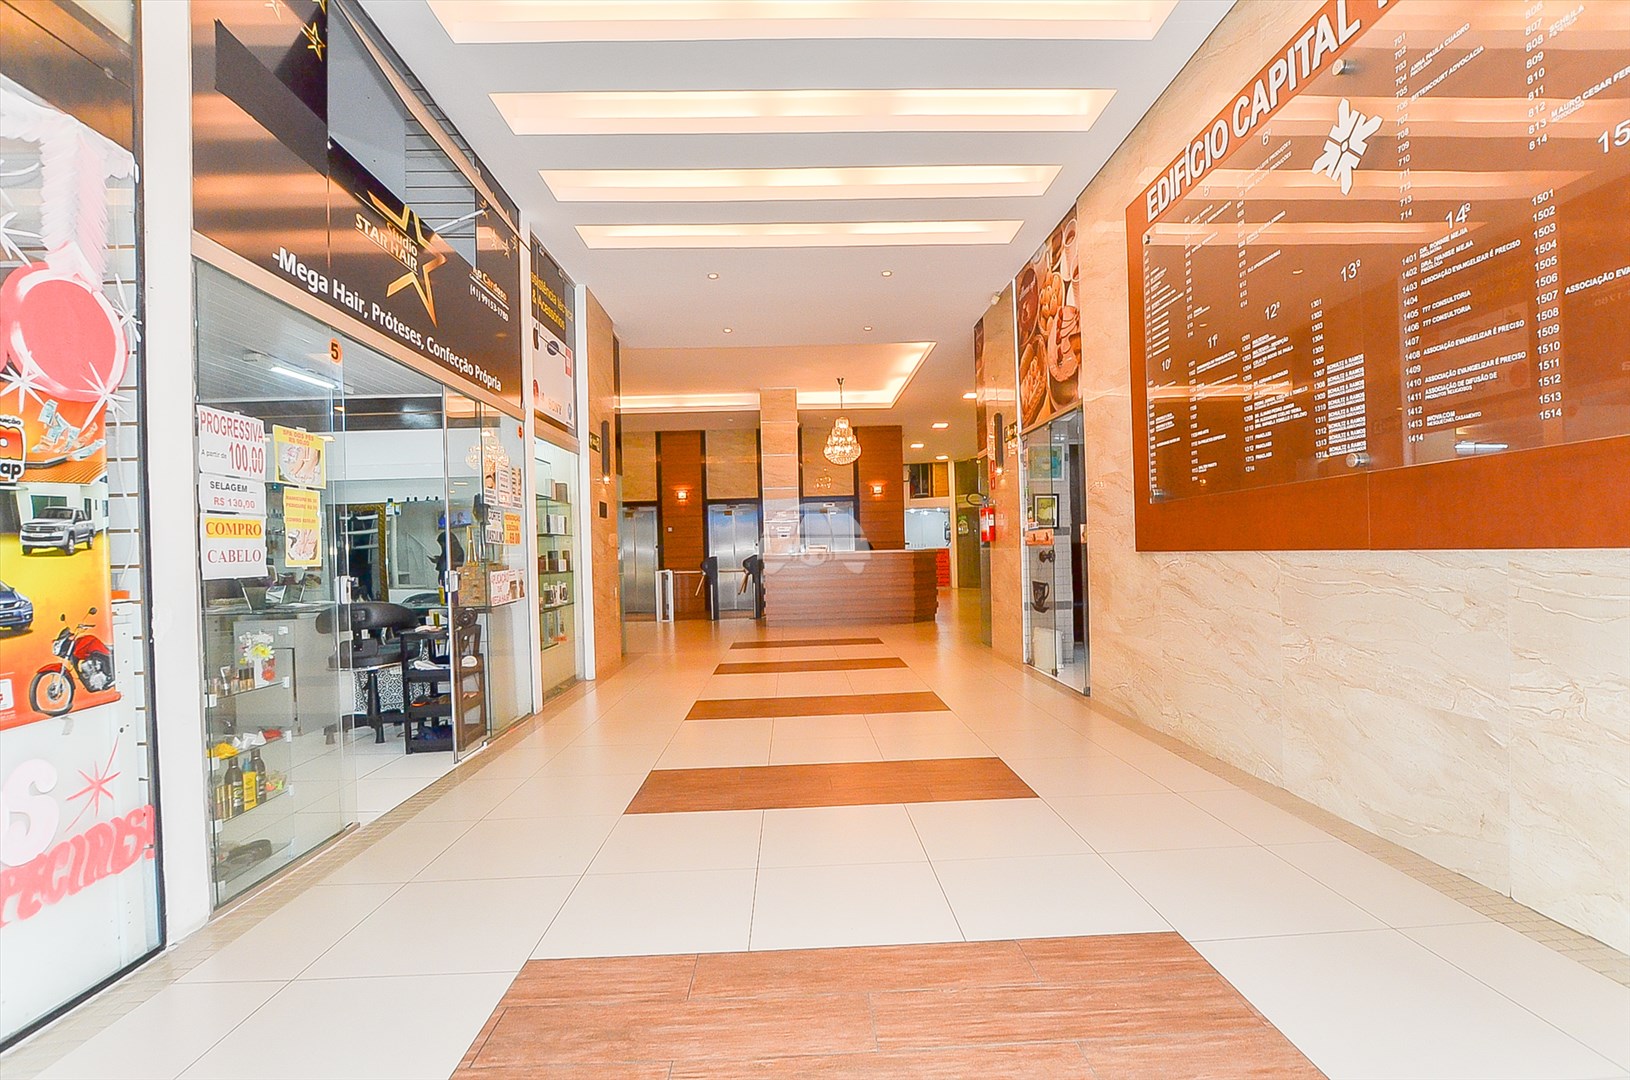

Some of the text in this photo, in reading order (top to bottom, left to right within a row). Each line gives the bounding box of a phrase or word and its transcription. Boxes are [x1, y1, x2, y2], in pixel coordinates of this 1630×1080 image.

[1524, 18, 1543, 36] 807
[1393, 32, 1407, 47] 701
[1525, 34, 1544, 52] 808
[1394, 46, 1407, 60] 702
[1526, 51, 1545, 69] 809
[1394, 60, 1407, 74] 703
[1411, 70, 1449, 102] BITTENCOURT
[1448, 46, 1485, 75] ADVOCACIA
[1395, 74, 1407, 87] 704
[1526, 68, 1545, 85] 810
[1395, 87, 1408, 99] 705
[1528, 86, 1545, 101] 811
[1146, 0, 1361, 223] EDIFÍCIO CAPITAL
[1528, 119, 1547, 135] 813
[1551, 96, 1581, 118] MAURO
[1582, 78, 1612, 100] CESAR
[1528, 102, 1546, 117] 812
[1397, 128, 1410, 140] 708
[1397, 141, 1410, 153] 709
[1528, 133, 1548, 151] 814
[1398, 154, 1411, 167] 710
[1400, 195, 1412, 207] 713
[1532, 188, 1554, 207] 1501
[1400, 208, 1413, 221] 714
[1445, 203, 1471, 230] 14º
[1532, 205, 1556, 224] 1502
[1533, 222, 1557, 240] 1503
[355, 213, 418, 273] STAR HAIR
[386, 221, 418, 257] Studio
[1534, 239, 1557, 256] 1504
[1402, 253, 1417, 267] 1401
[1402, 282, 1418, 295] 1403
[1420, 268, 1453, 286] ASSOCIAÇÃO
[1452, 252, 1489, 273] EVANGELIZAR
[1489, 247, 1494, 258] É
[1494, 239, 1521, 256] PRECISO
[1534, 256, 1558, 272] 1505
[1340, 259, 1361, 282] 13º
[1402, 266, 1418, 280] 1402
[1534, 272, 1558, 288] 1506
[530, 271, 557, 305] ssistência
[1536, 290, 1559, 306] 1507
[1564, 272, 1614, 296] ASSOCIAÇÃO
[1310, 298, 1322, 308] 1301
[1402, 295, 1418, 307] 1404
[1403, 290, 1471, 320] 1405 CONSULTORIA
[1265, 301, 1280, 320] 12º
[1311, 310, 1322, 320] 1302
[1536, 307, 1560, 322] 1508
[272, 247, 502, 392] -Mega Hair, Próteses, Confecção Própria
[1404, 304, 1471, 334] 1406 CONSULTORIA
[1312, 322, 1324, 332] 1303
[1536, 324, 1560, 339] 1509
[1312, 334, 1324, 344] 1304
[1404, 319, 1525, 362] 1408 ASSOCIAÇÃO EVANGELIZAR É PRECISO
[1404, 336, 1420, 348] 1407
[330, 342, 339, 361] 5
[1312, 345, 1324, 354] 1305
[1537, 340, 1560, 356] 1510
[1313, 356, 1325, 366] 1306
[1538, 358, 1560, 371] 1511
[1314, 368, 1325, 378] 1307
[1405, 364, 1422, 376] 1409
[1406, 351, 1527, 388] 1410 ASSOCIAÇÃO EVANGELIZAR É PRECISO
[1314, 380, 1326, 390] 1308
[1407, 371, 1498, 402] 1411 ASSOCIAÇÃO DE DIFUSÃO DE
[1538, 374, 1562, 388] 1512
[1314, 392, 1326, 401] 1309
[1538, 391, 1562, 405] 1513
[1314, 404, 1326, 412] 1310
[1407, 406, 1423, 416] 1412
[1539, 407, 1562, 421] 1514
[1315, 416, 1327, 424] 1311
[1407, 419, 1423, 429] 1413
[200, 411, 264, 444] PROGRESSIVA
[518, 427, 523, 438] 5
[1316, 426, 1327, 435] 1312
[1316, 438, 1328, 447] 1313
[1408, 433, 1424, 444] 1414
[206, 449, 221, 460] partir
[221, 452, 227, 460] de
[229, 442, 264, 477] 100,00
[210, 481, 248, 493] SELAGEM
[228, 498, 255, 509] 130,00
[206, 521, 262, 536] COMPRO
[207, 549, 262, 563] CABELO
